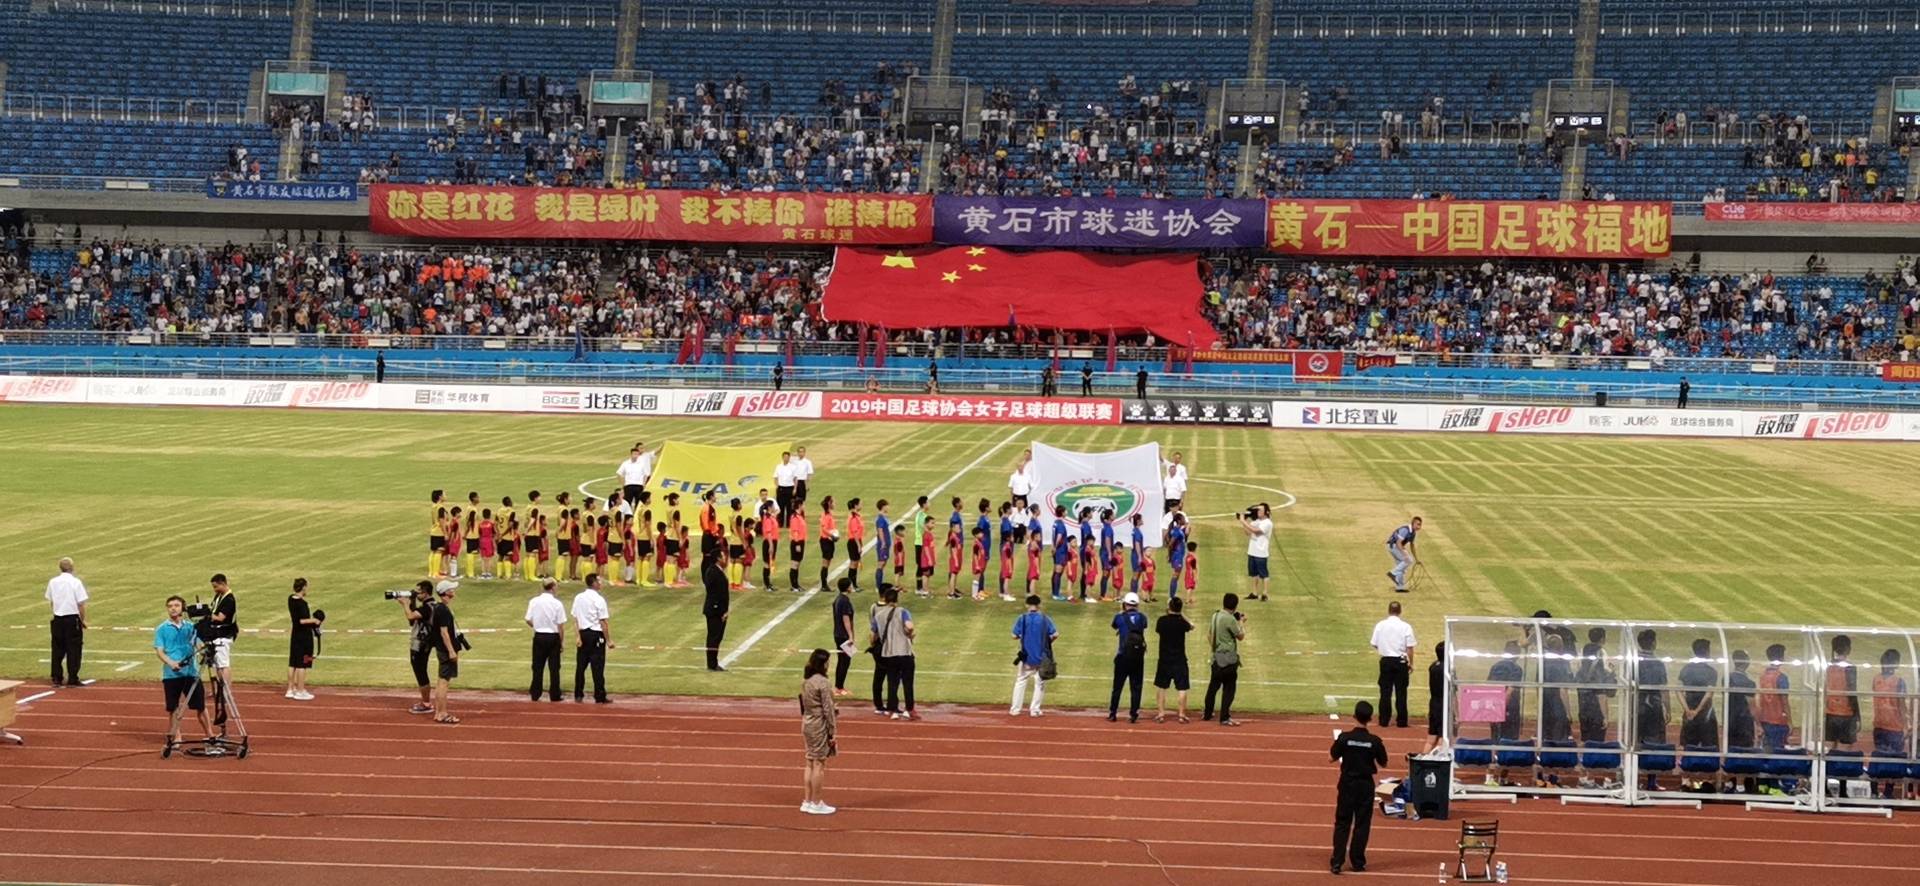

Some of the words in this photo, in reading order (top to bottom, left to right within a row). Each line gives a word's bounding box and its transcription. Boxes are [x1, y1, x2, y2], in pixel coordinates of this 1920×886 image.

[387, 190, 515, 221] 你是红花
[534, 193, 660, 223] 我是绿叶
[957, 206, 1242, 236] 黄石市球迷协会
[781, 228, 854, 241] 黄石球迷
[584, 392, 658, 410] 北控集团
[830, 398, 1113, 420] 2019中国足球协会女子足球超级联赛
[1325, 408, 1398, 425] 北控置业
[661, 478, 728, 494] FIFA
